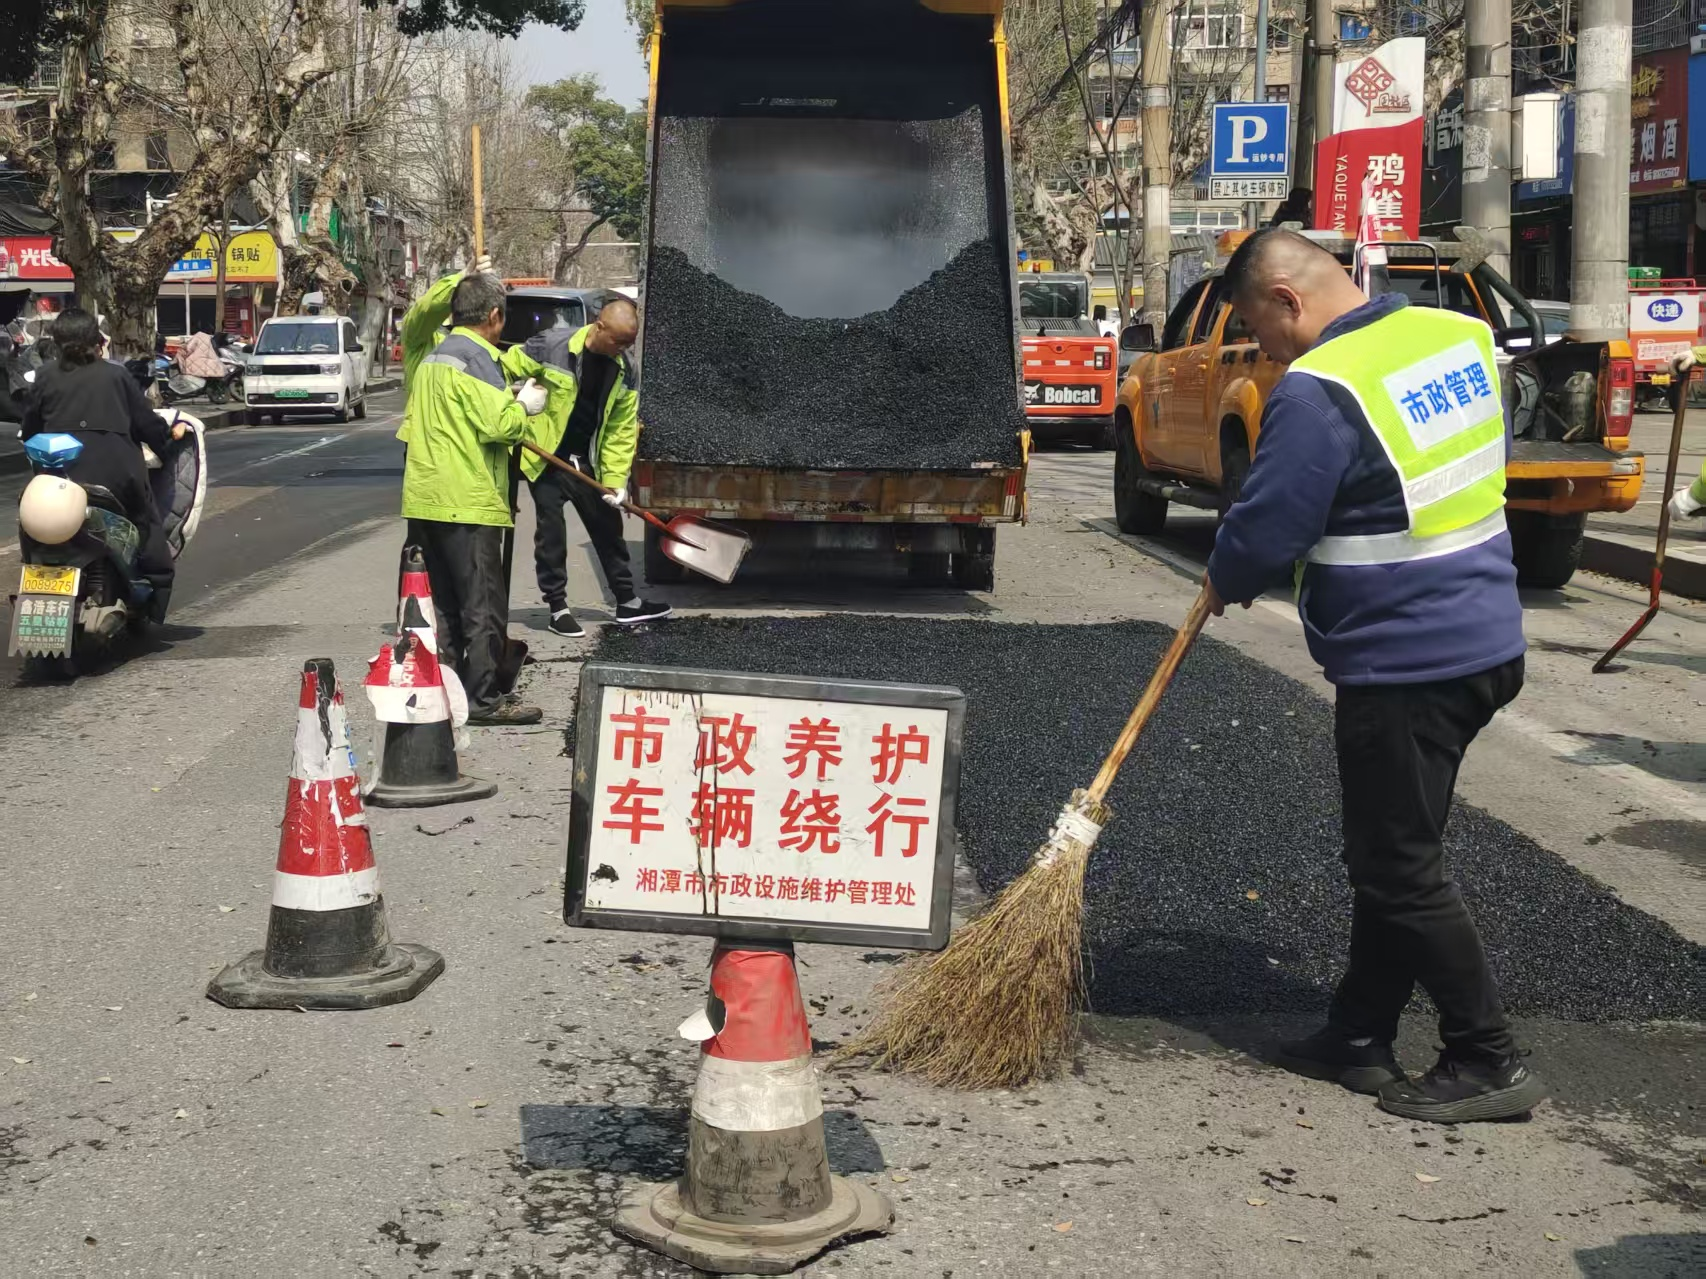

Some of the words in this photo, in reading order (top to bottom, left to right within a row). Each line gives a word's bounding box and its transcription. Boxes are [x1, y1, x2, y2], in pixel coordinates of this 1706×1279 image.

[1226, 115, 1268, 163] P
[1214, 181, 1285, 197] 禁止其他车辆停放
[1367, 152, 1406, 232] 鸦雀
[231, 247, 260, 262] 锅贴
[1651, 303, 1680, 318] 快递
[1044, 386, 1097, 404] Bobcat
[1400, 361, 1492, 424] 市政管理
[24, 579, 73, 592] 0089275
[609, 705, 930, 786] 市政养护
[602, 777, 930, 859] 车辆绕行
[635, 866, 917, 907] 湘潭市市政设施维护管理处
